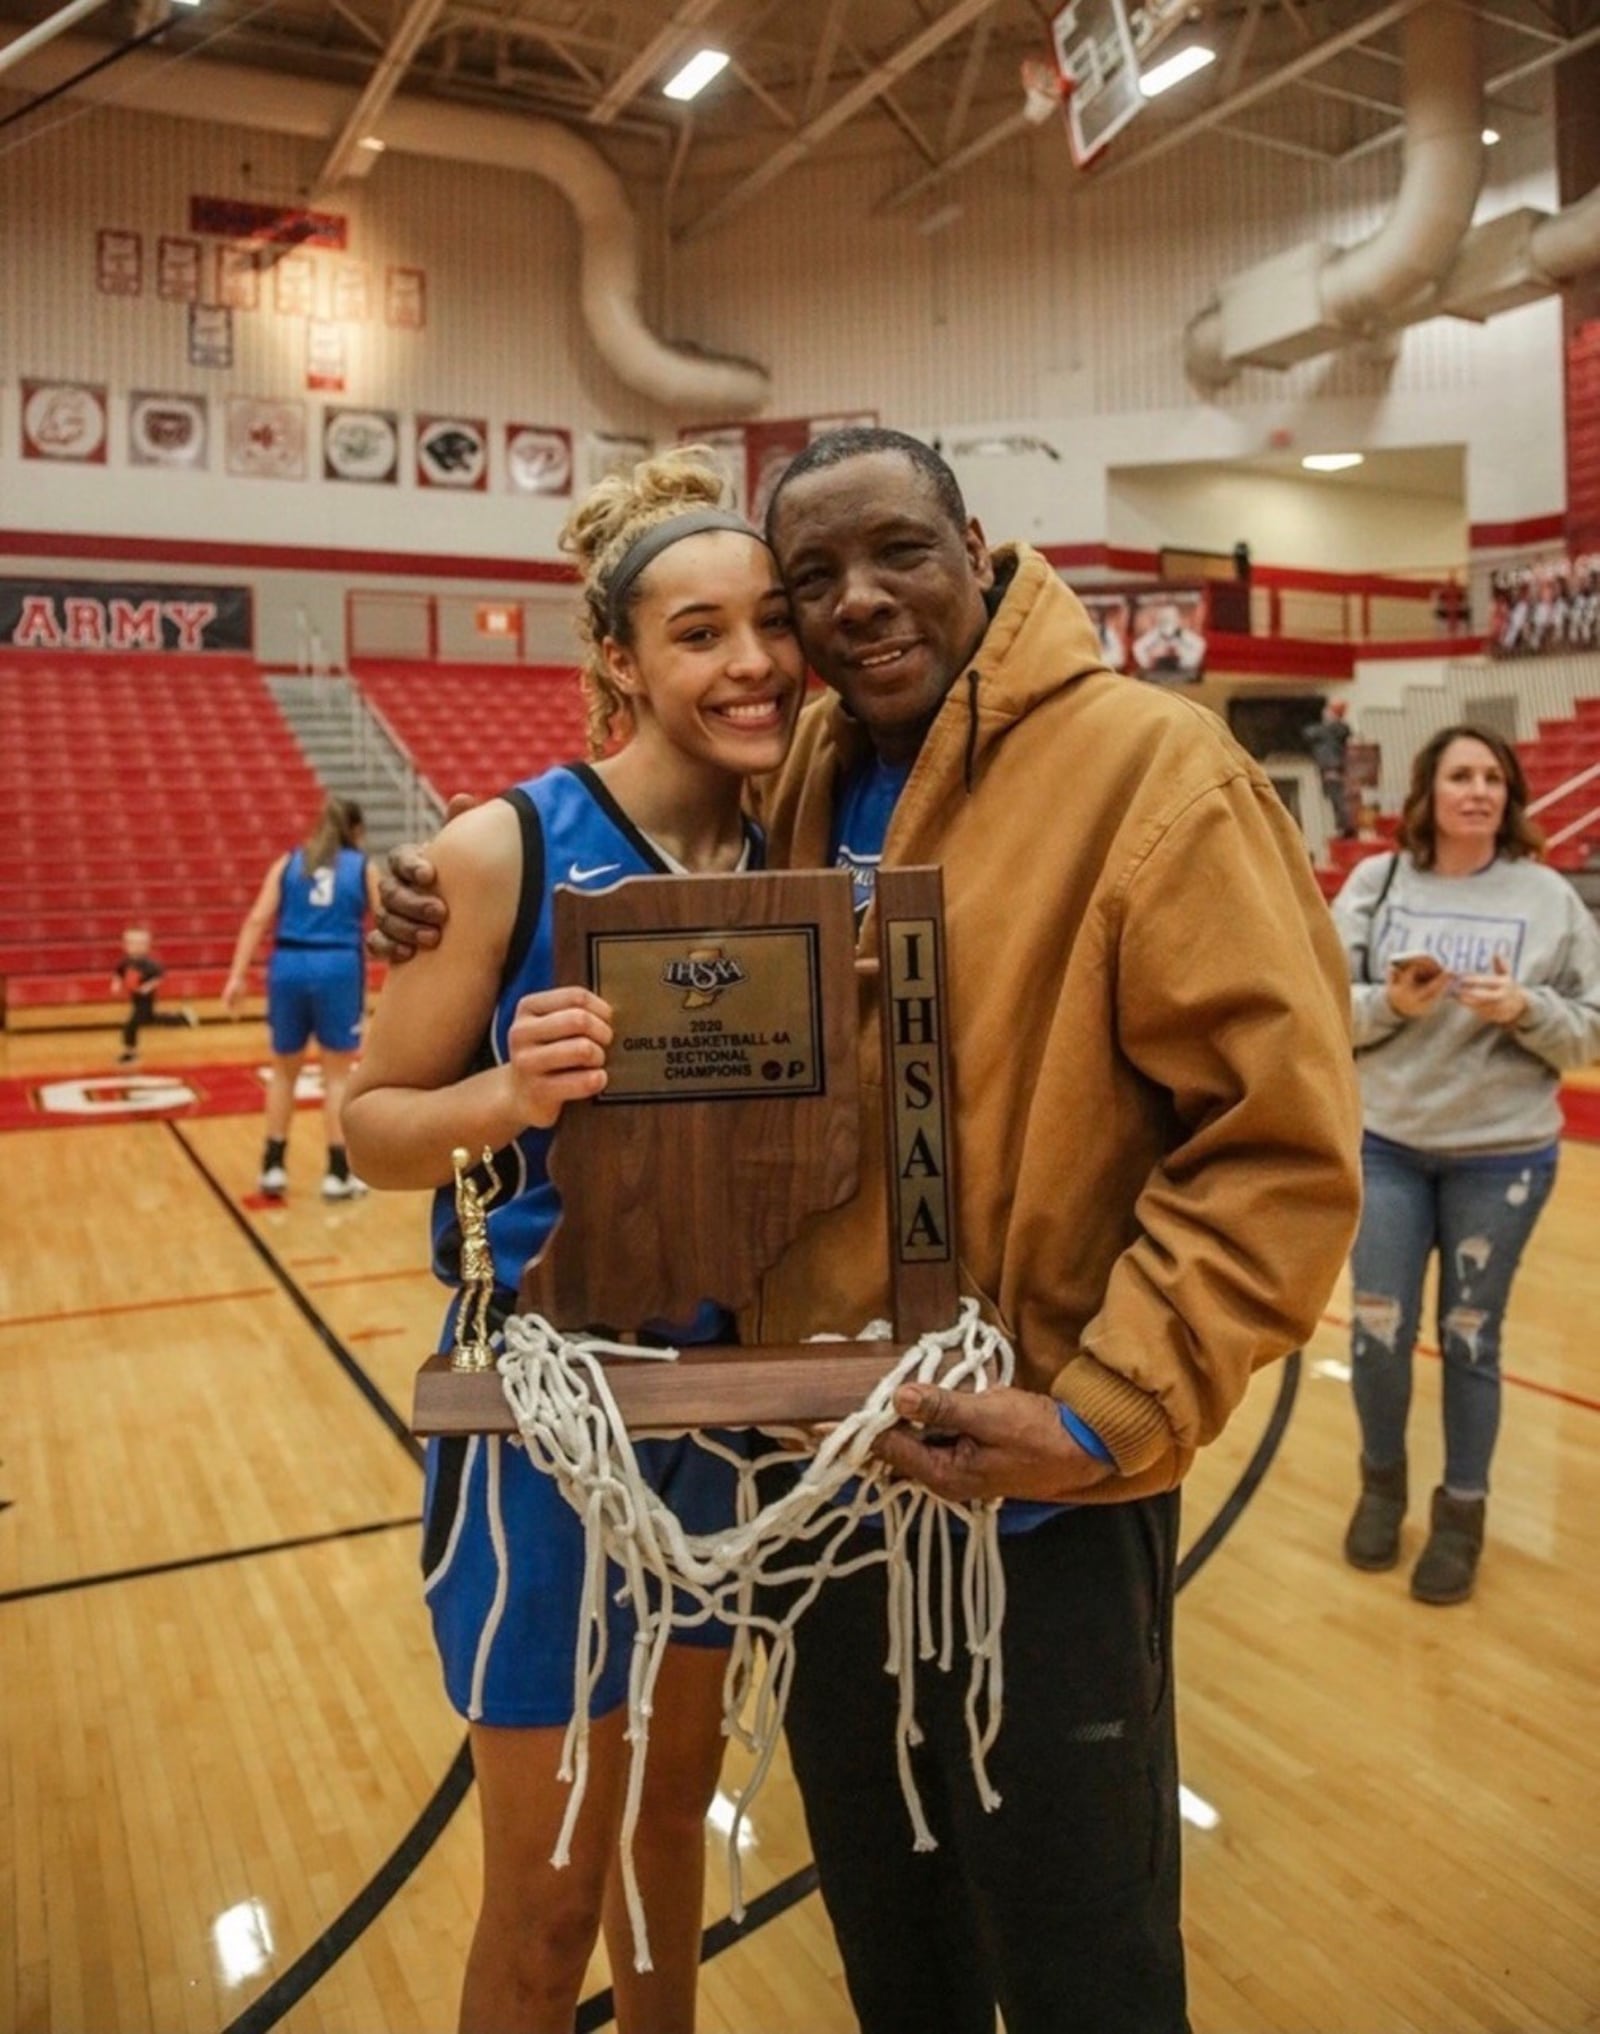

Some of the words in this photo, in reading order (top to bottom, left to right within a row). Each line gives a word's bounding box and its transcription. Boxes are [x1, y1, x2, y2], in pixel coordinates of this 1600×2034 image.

[13, 596, 217, 649] ARMY
[308, 866, 335, 907] 3
[663, 957, 743, 989] IHSAA
[690, 1019, 723, 1033] 2020
[623, 1036, 668, 1051] GIRLS
[671, 1033, 769, 1049] BASKETBALL
[771, 1031, 791, 1045] 4A
[665, 1050, 749, 1065] SECTIONAL
[664, 1064, 752, 1081] CHAMPIONS
[896, 932, 943, 1247] IHSAA
